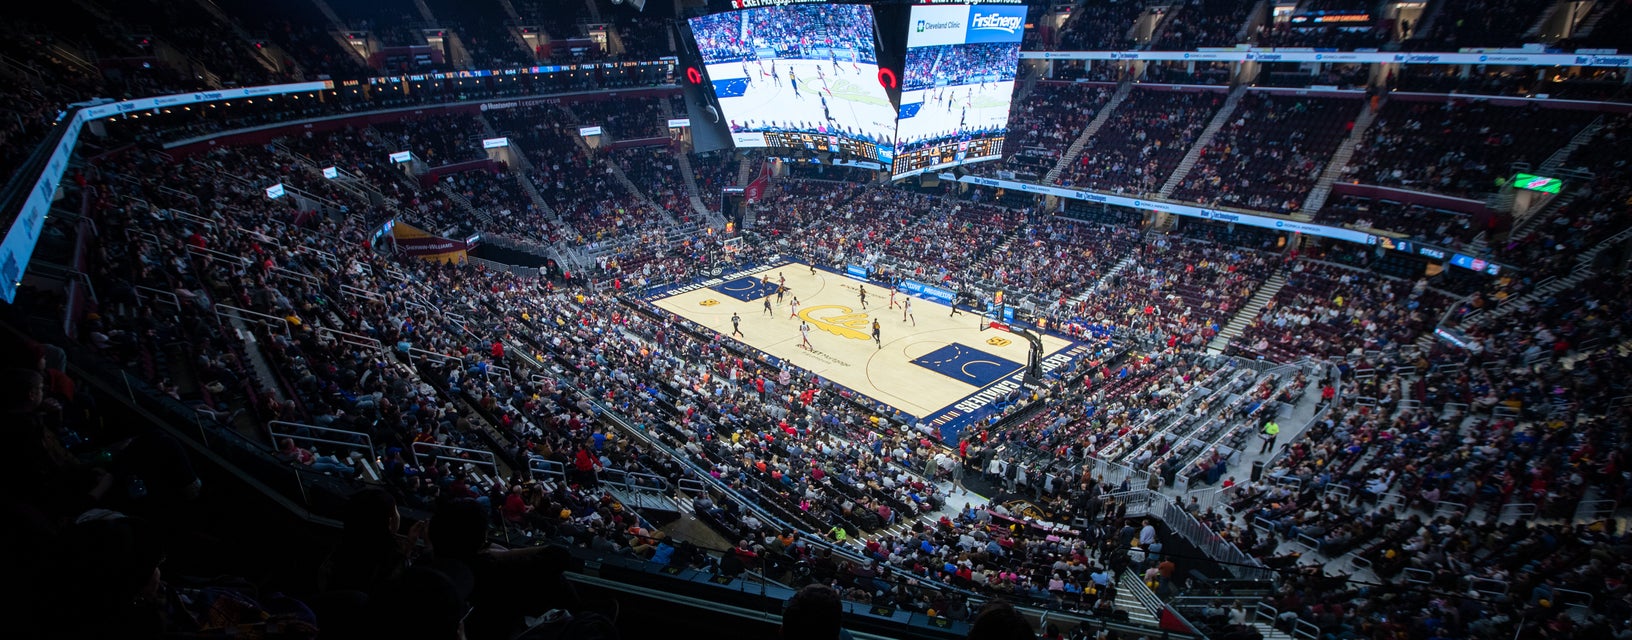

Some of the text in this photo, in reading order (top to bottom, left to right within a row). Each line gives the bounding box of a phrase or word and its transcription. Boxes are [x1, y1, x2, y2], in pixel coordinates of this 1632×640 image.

[925, 21, 961, 30] Cleveland Clinic
[972, 12, 1022, 30] FirstEnergy
[953, 380, 1021, 414] CAVALIERS
